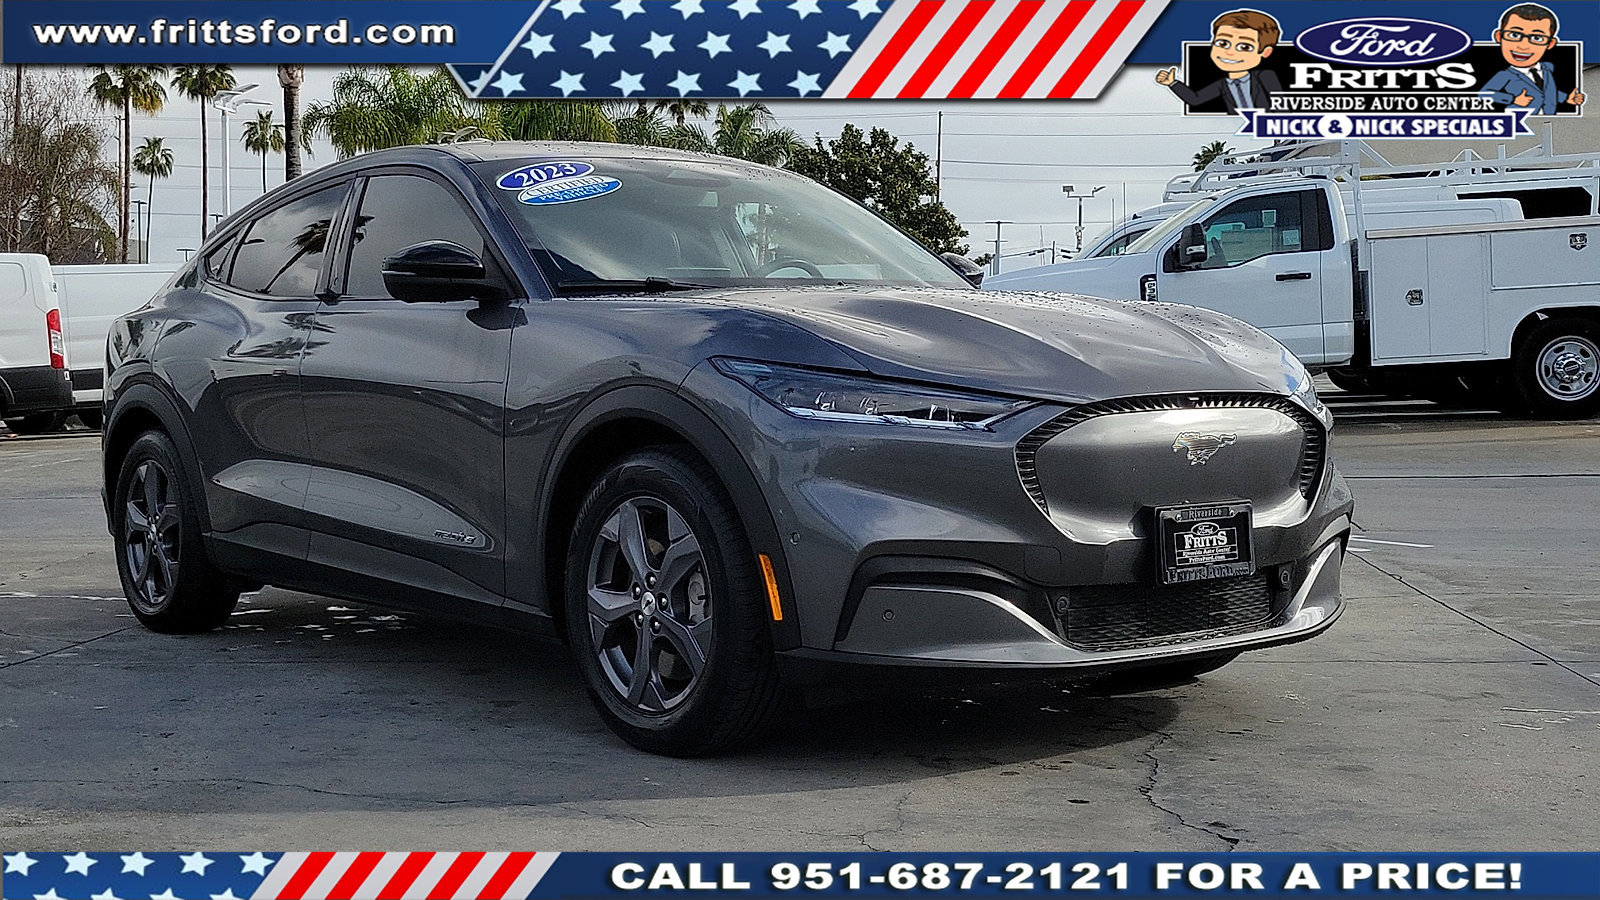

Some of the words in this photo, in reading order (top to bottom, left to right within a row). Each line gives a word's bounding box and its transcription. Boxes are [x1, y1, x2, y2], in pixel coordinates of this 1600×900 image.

[514, 163, 577, 187] 2023
[1189, 509, 1222, 518] Riverside
[1184, 531, 1228, 549] FRITTS
